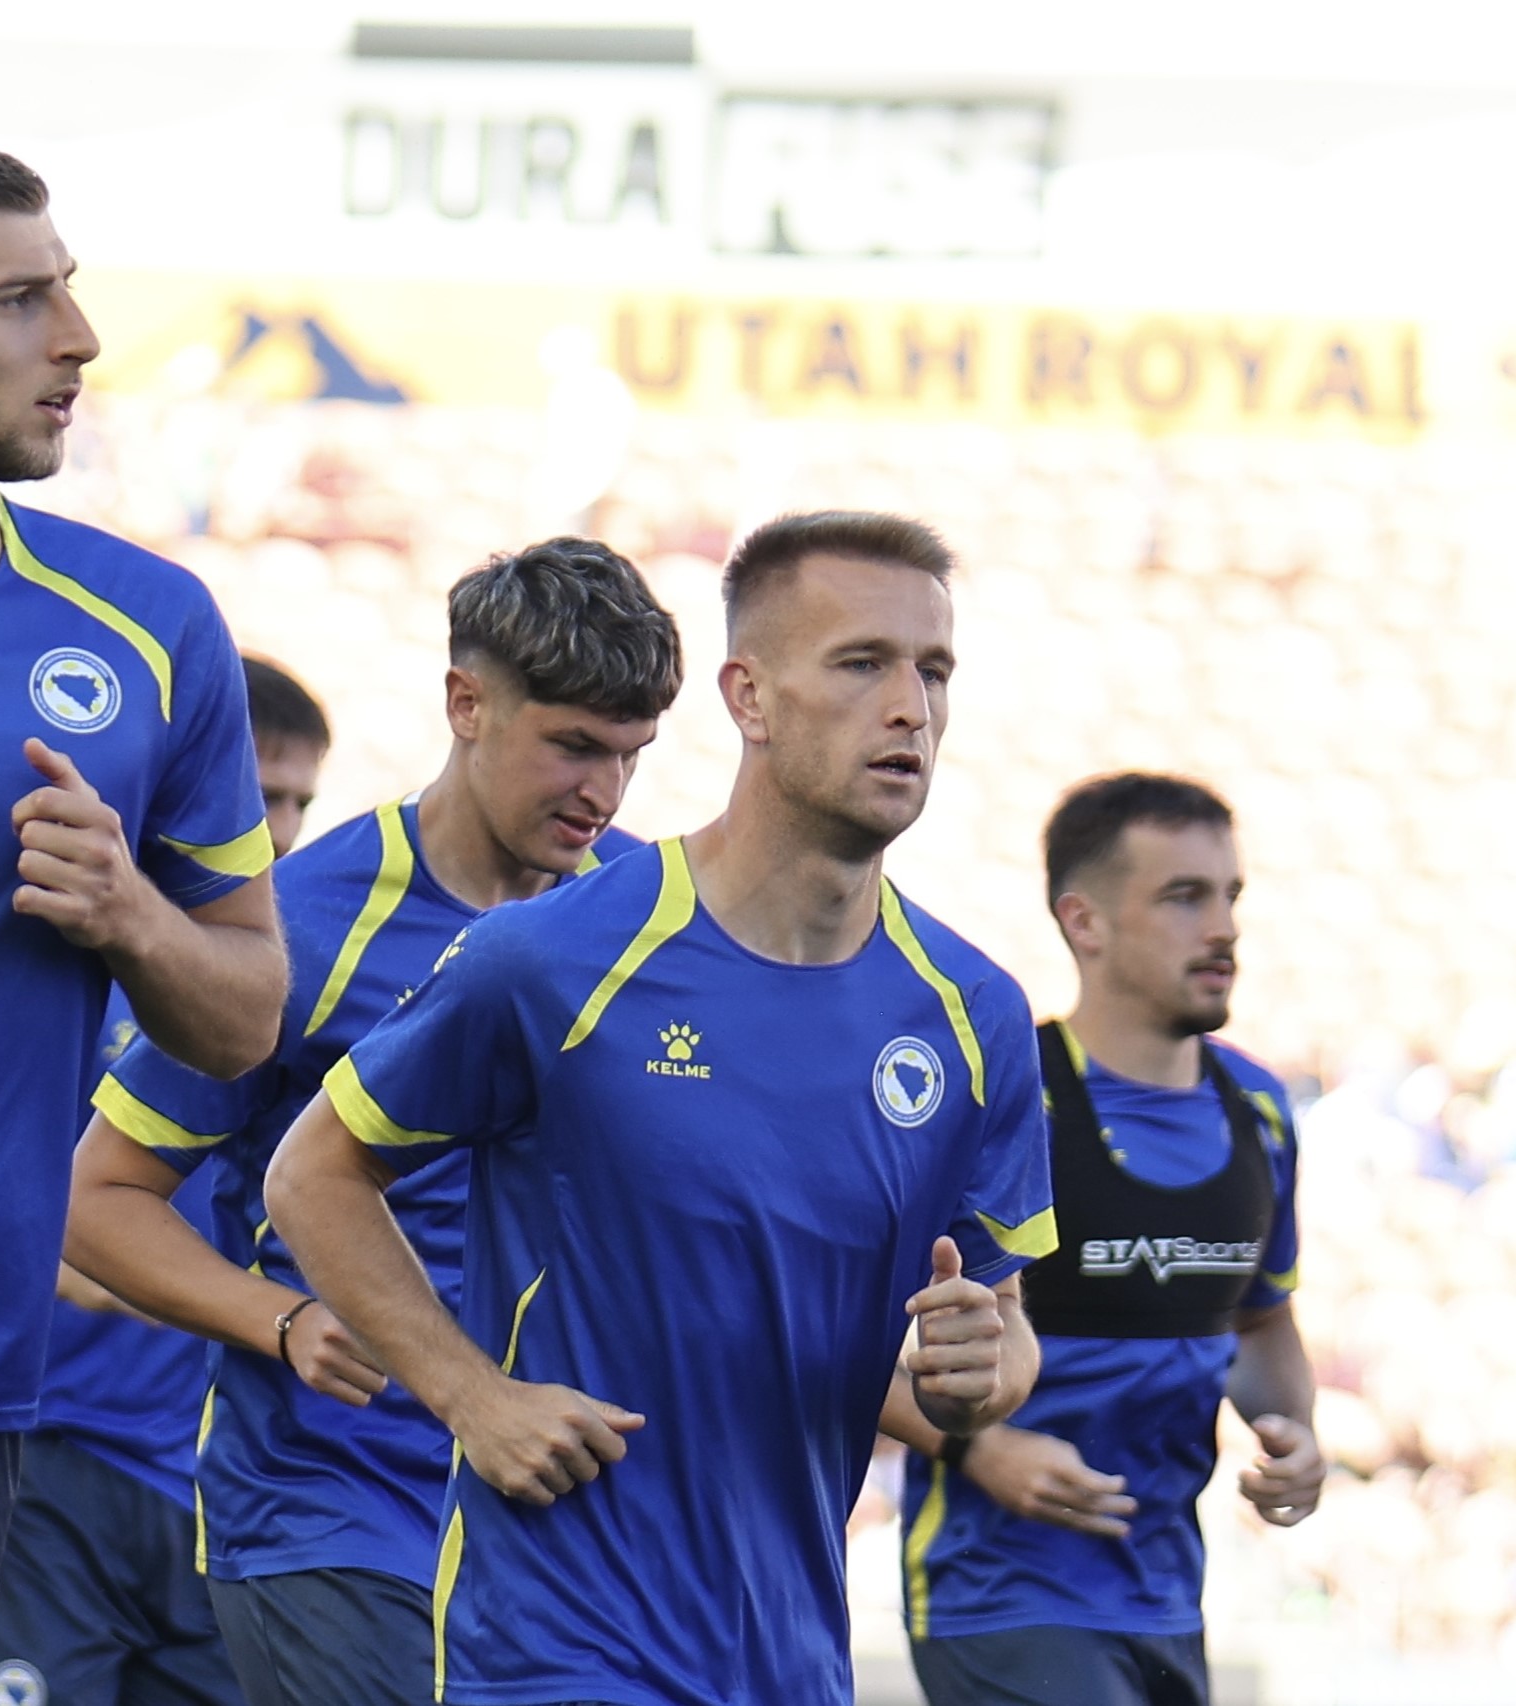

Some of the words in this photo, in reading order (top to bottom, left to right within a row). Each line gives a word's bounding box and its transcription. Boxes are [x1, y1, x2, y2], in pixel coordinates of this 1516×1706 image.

[341, 104, 675, 226] DURA
[615, 306, 981, 404] UTAH
[1025, 320, 1516, 428] ROYAL
[645, 1059, 712, 1080] KELME
